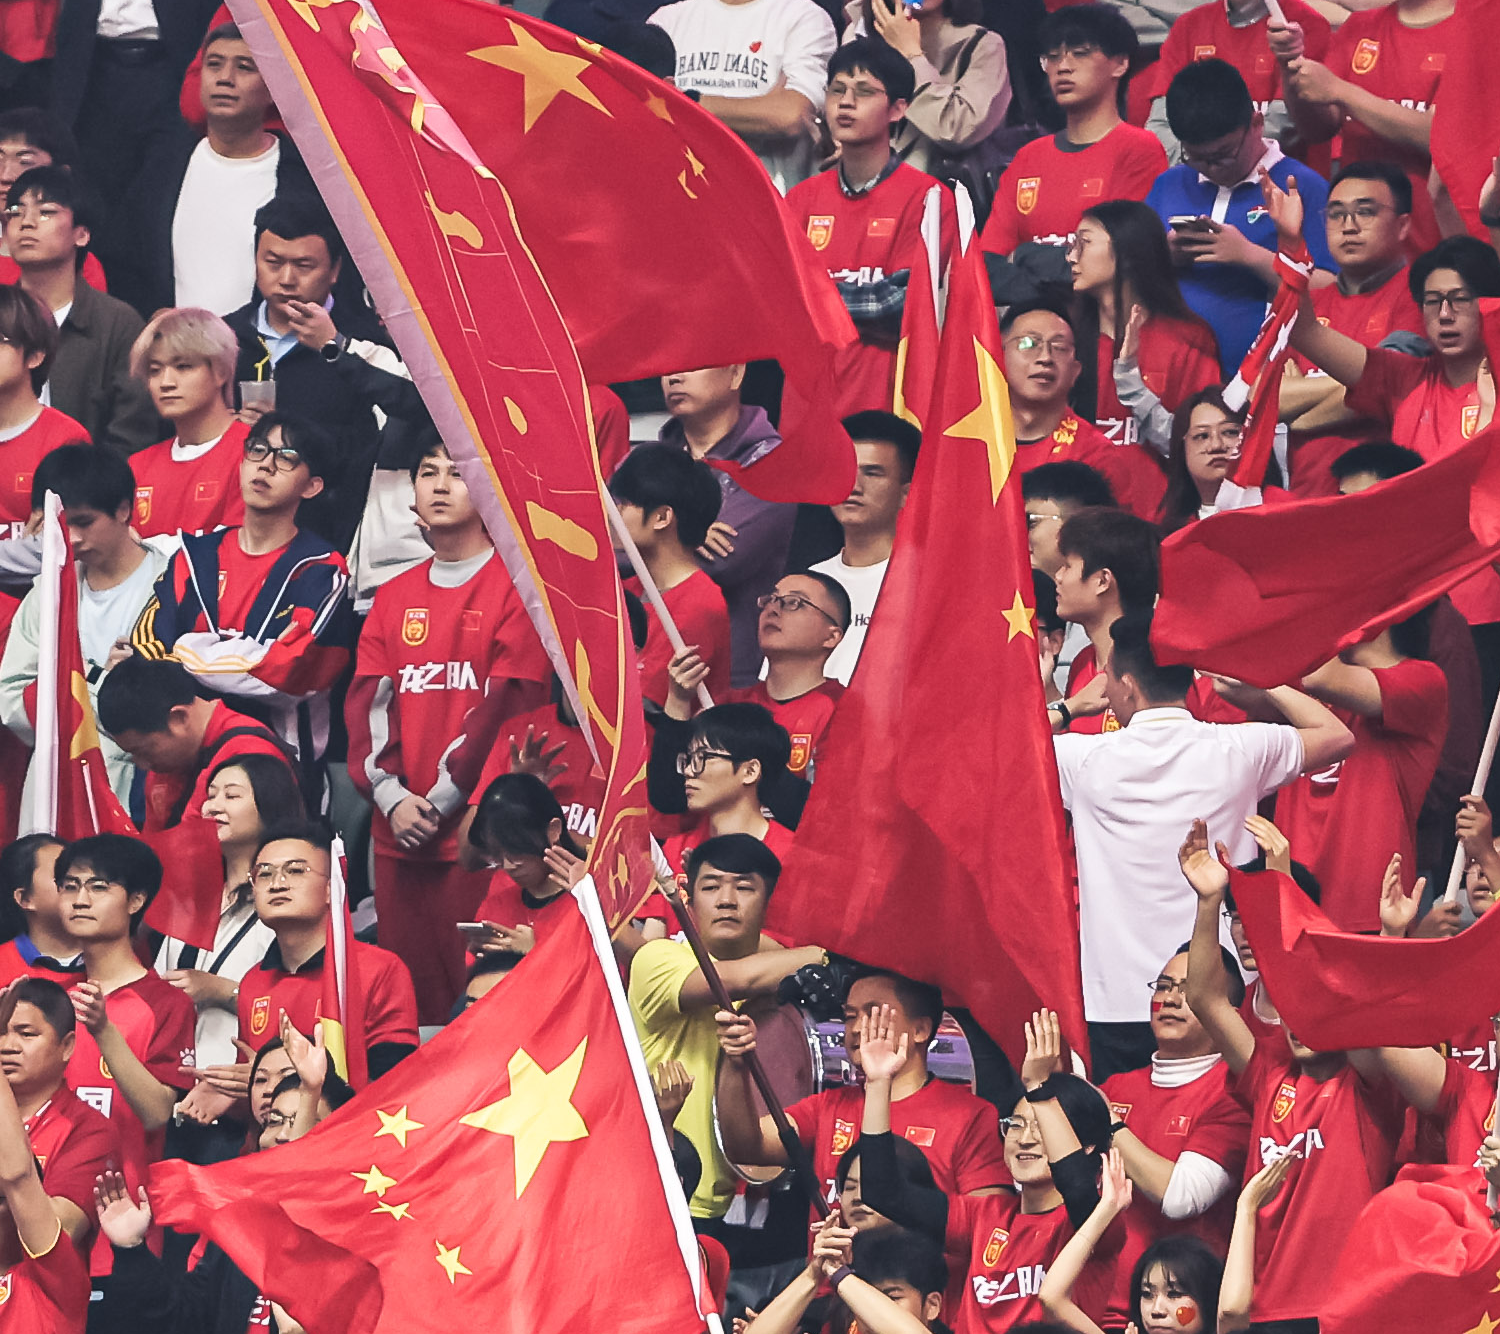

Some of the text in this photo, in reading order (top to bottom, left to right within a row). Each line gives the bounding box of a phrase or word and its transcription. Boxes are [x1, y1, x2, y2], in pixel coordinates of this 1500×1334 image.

[723, 52, 769, 84] IMAGE
[399, 662, 478, 693] 龙之队
